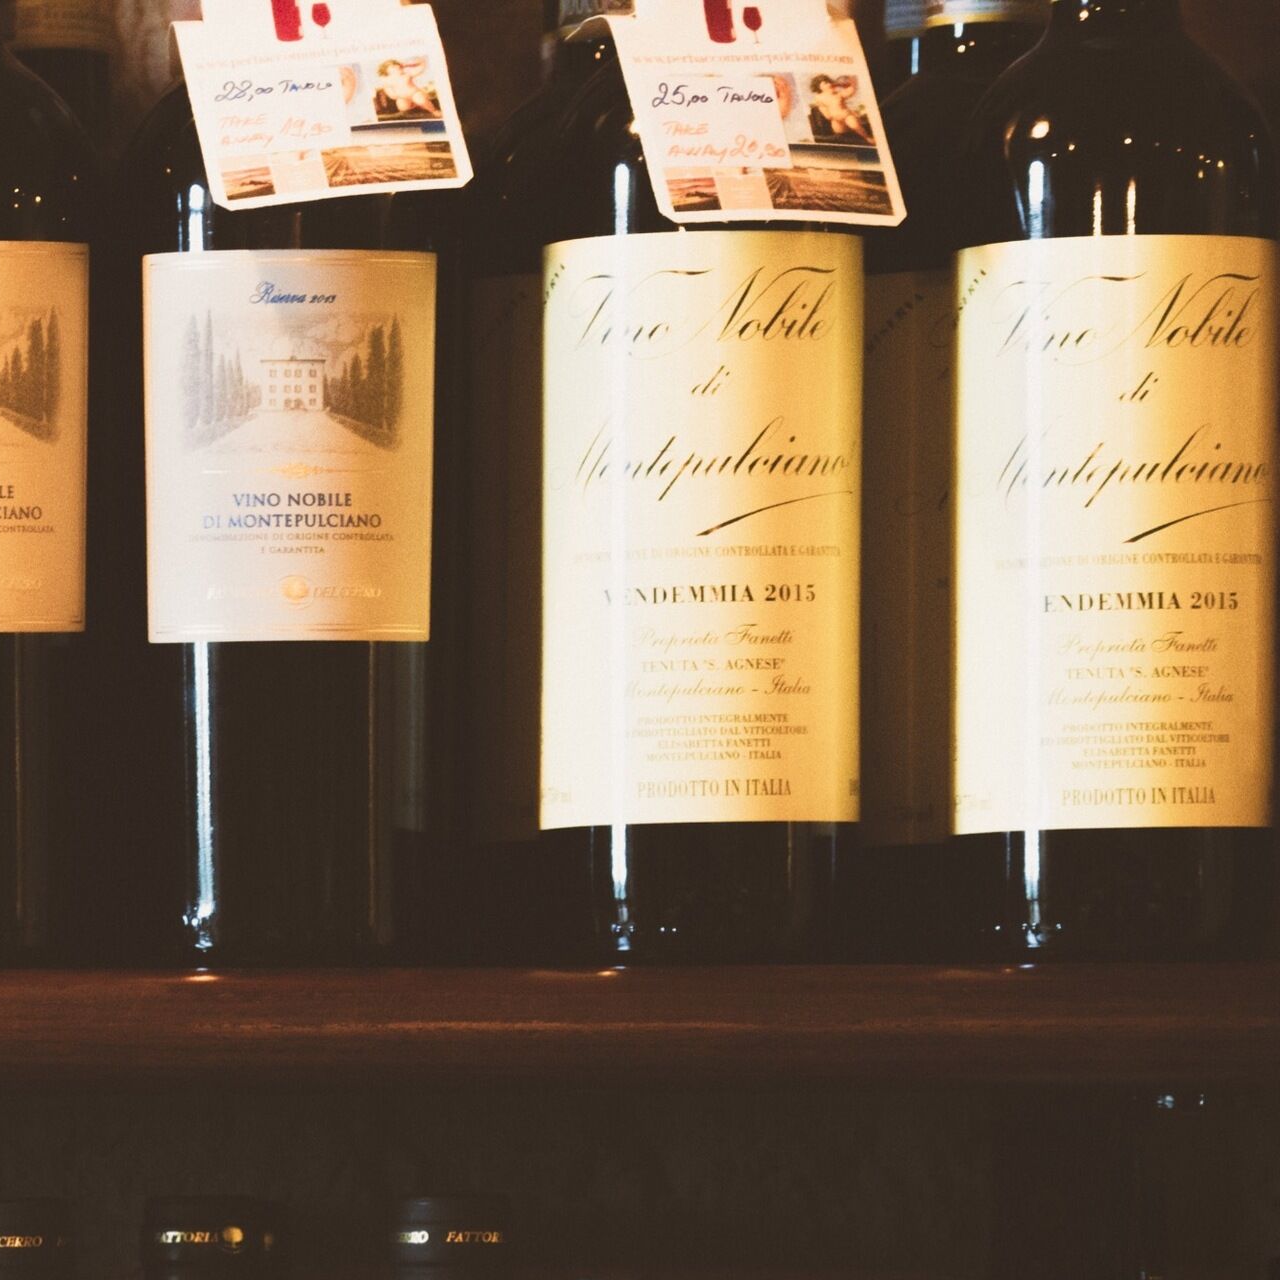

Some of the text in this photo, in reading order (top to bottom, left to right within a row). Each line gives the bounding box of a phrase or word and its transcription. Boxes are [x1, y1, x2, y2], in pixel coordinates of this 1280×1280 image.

[650, 81, 709, 108] 25,00
[680, 266, 839, 350] Nobile
[1108, 272, 1262, 355] Nobile
[691, 364, 731, 395] di
[232, 492, 353, 508] VINO NOBILE
[227, 513, 382, 529] MONTEPULCIANO
[764, 583, 816, 603] 2015
[1190, 591, 1240, 611] 2015
[724, 779, 742, 796] IN
[745, 778, 792, 797] ITALIA
[1061, 787, 1217, 807] PRODOTTO IN ITALIA
